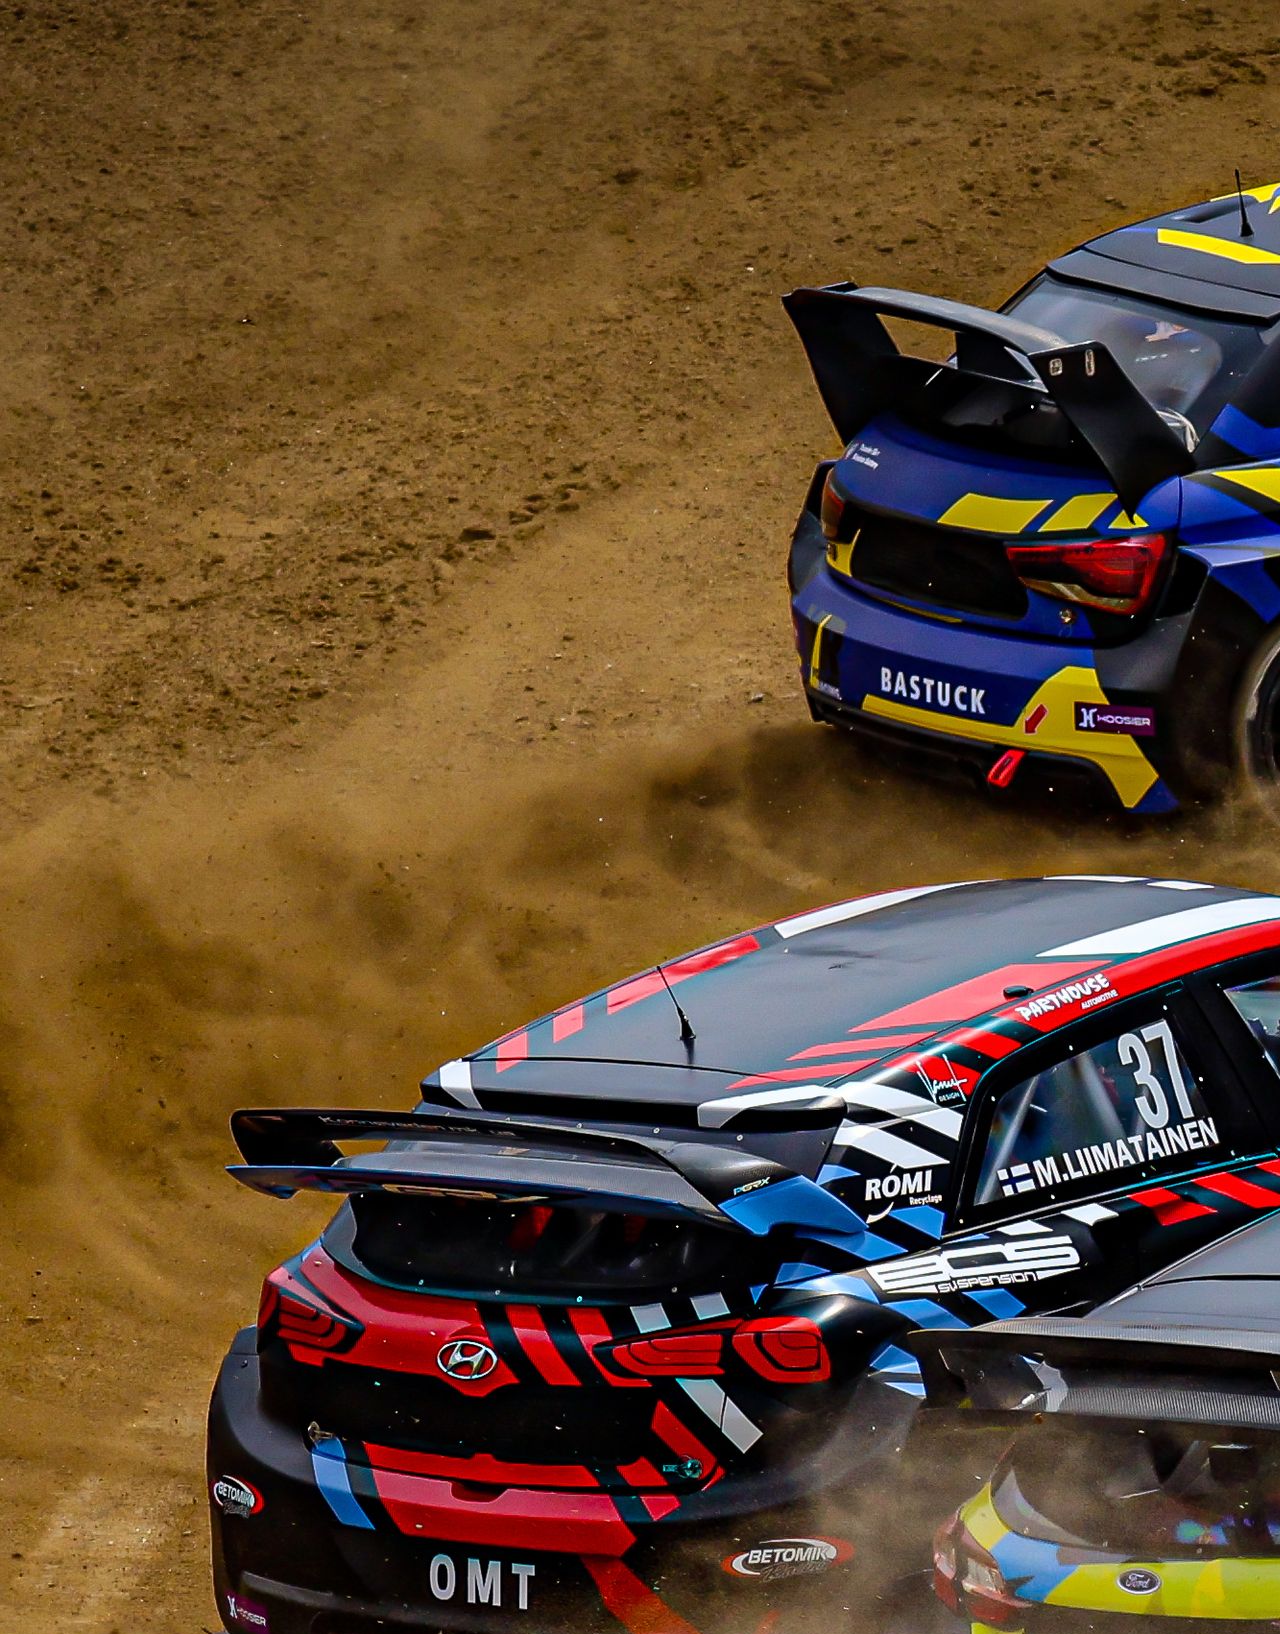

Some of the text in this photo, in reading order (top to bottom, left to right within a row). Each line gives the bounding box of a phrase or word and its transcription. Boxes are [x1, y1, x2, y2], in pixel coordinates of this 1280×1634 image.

[881, 666, 986, 714] BASTUCK
[1096, 714, 1151, 727] HOOSIER
[1014, 973, 1110, 1022] PARTHOUSE
[1080, 989, 1119, 1010] AUTOMOTIVE
[1118, 1018, 1195, 1129] 37
[1033, 1117, 1221, 1188] M.LIIMATAINEN
[865, 1169, 933, 1201] ROMI
[909, 1193, 943, 1206] Recyclage
[749, 1547, 829, 1565] BETOMIK
[429, 1553, 536, 1610] OMT
